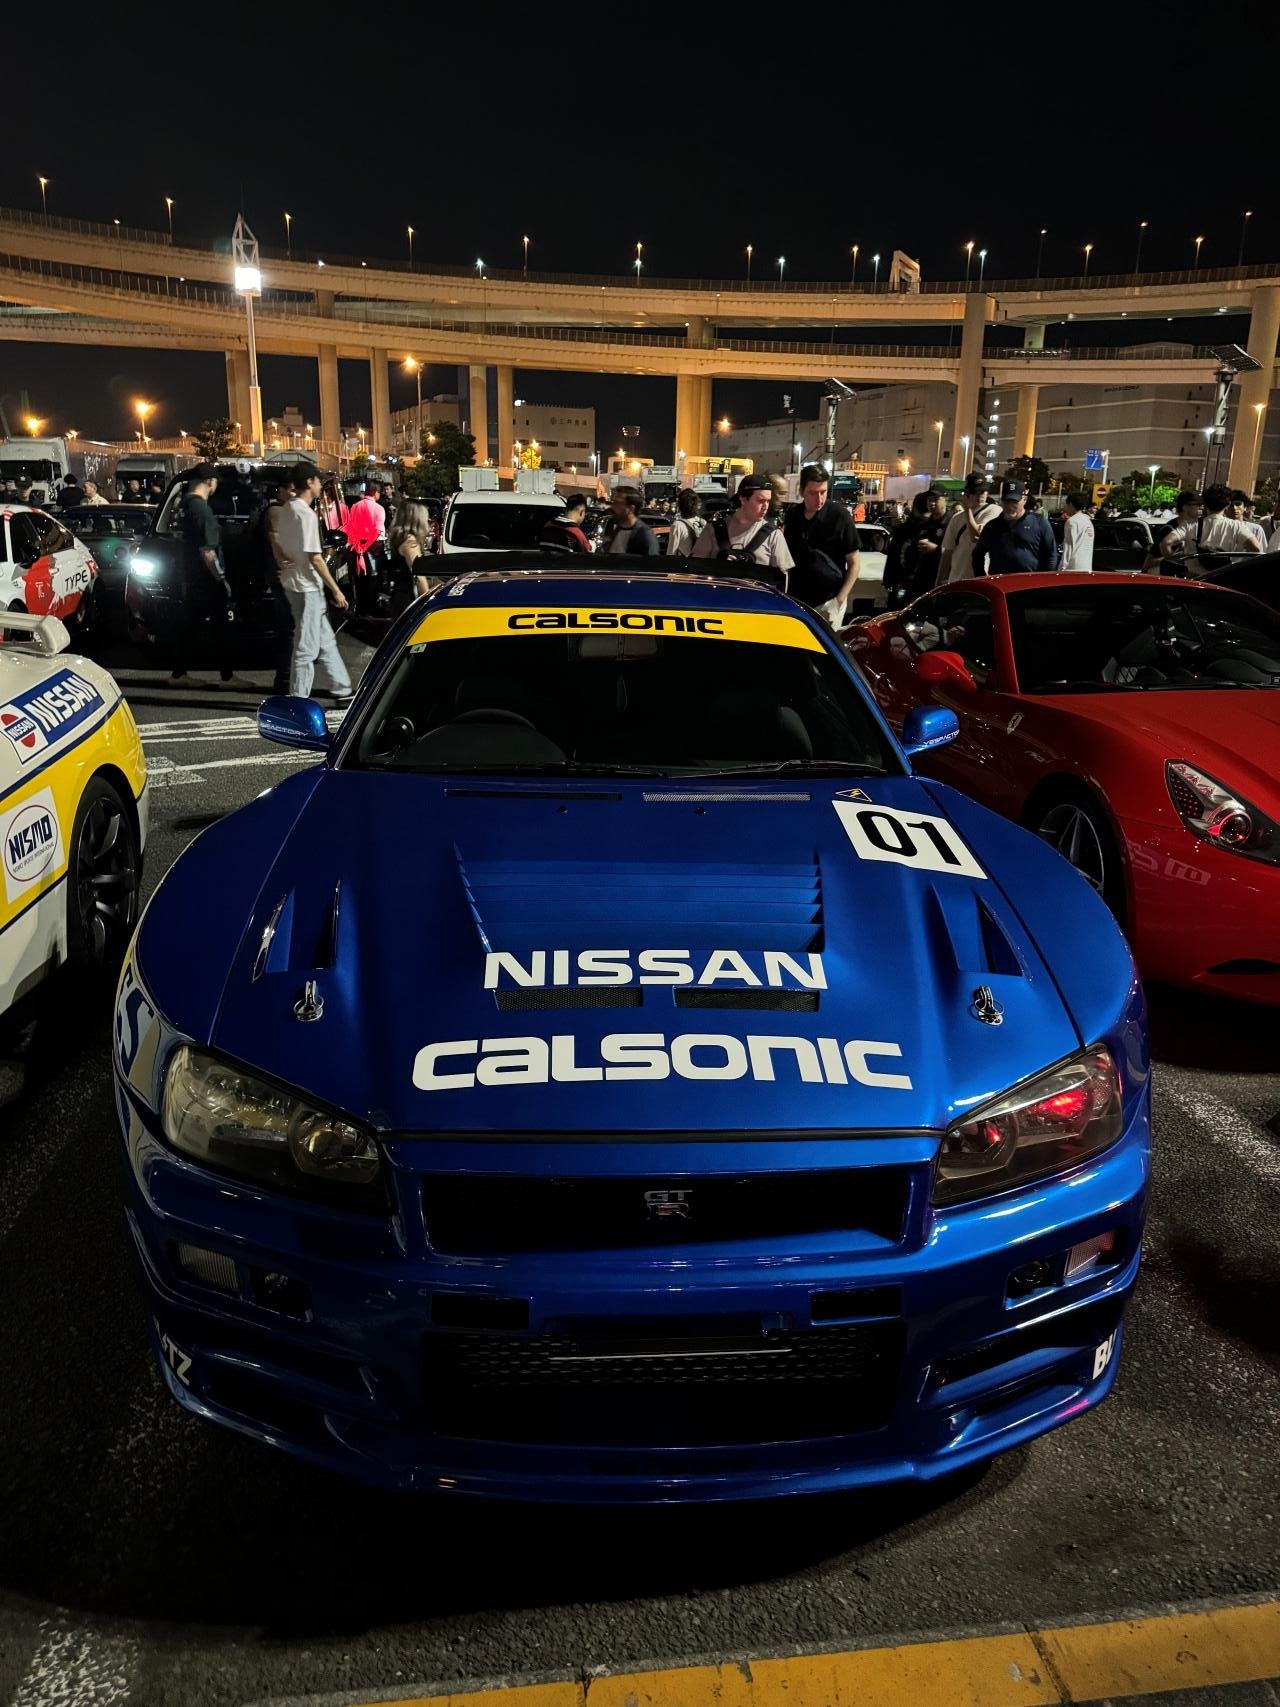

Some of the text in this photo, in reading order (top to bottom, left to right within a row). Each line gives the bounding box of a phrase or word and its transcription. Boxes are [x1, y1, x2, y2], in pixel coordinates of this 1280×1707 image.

[65, 570, 88, 592] TYPE
[23, 674, 98, 732] NISSAN
[7, 719, 35, 739] NISSAN
[9, 814, 53, 865] NISMO
[856, 811, 961, 866] 01
[484, 949, 828, 989] NISSAN
